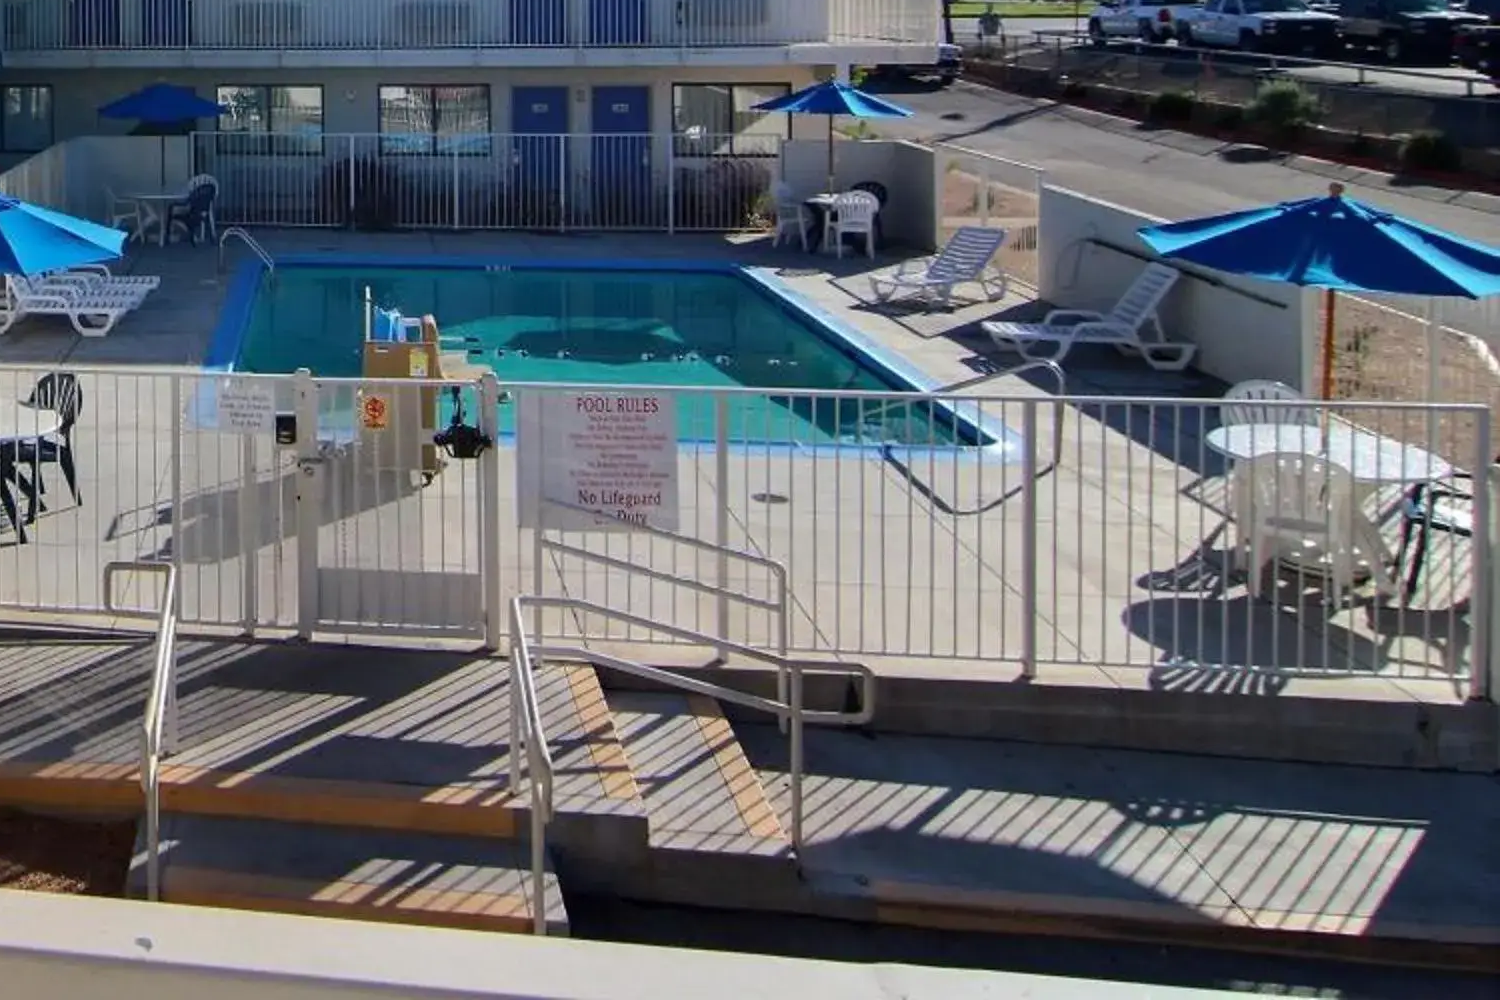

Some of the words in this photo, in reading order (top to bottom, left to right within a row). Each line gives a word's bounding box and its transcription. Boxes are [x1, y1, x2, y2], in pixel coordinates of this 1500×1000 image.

[576, 397, 612, 413] POOL
[617, 397, 659, 413] RULES
[578, 489, 598, 505] No
[601, 489, 662, 508] Lifeguard
